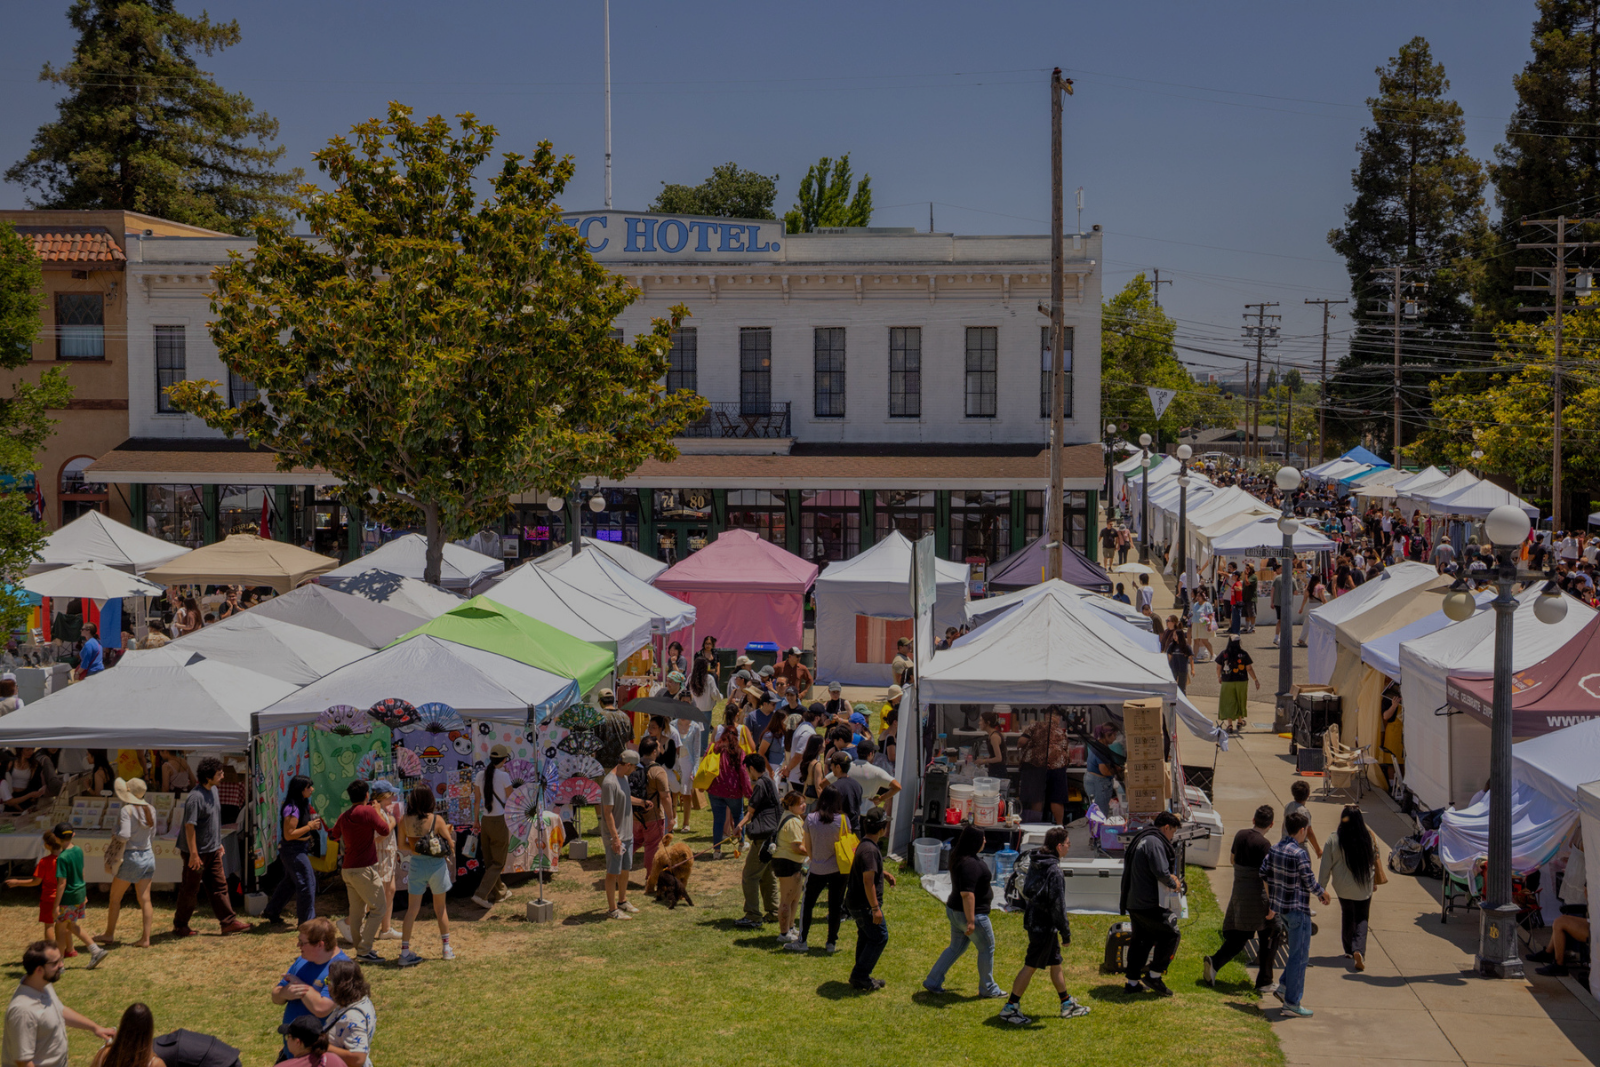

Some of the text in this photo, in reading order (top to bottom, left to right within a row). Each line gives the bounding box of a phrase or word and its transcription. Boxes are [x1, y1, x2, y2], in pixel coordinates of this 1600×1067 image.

[624, 217, 780, 253] HOTEL.
[661, 495, 675, 508] 74
[690, 495, 705, 508] 80
